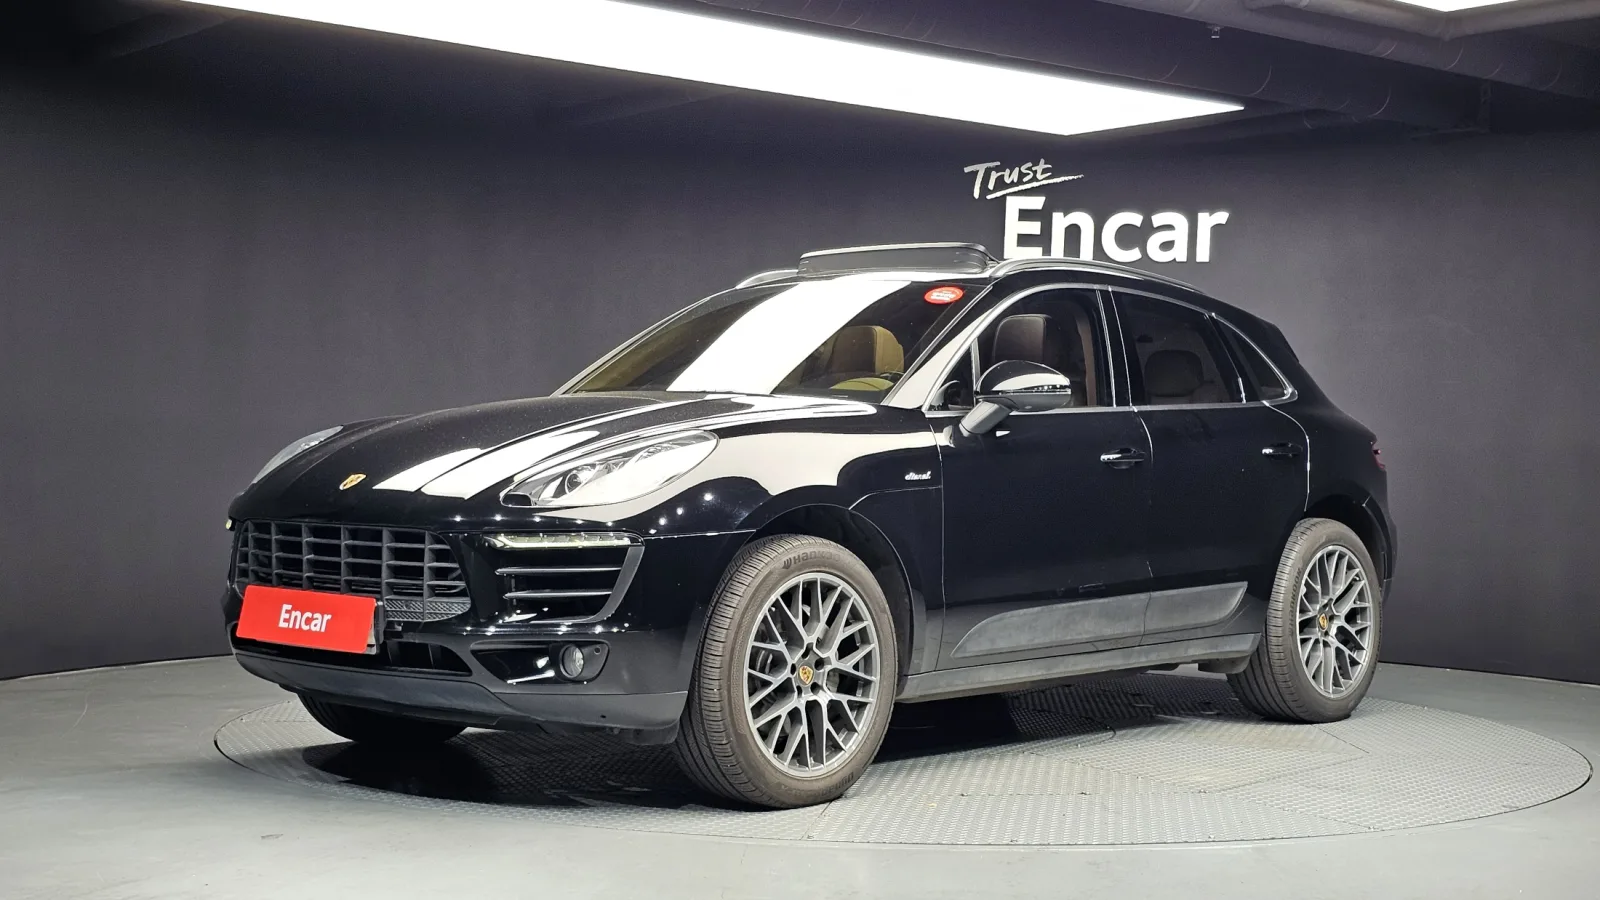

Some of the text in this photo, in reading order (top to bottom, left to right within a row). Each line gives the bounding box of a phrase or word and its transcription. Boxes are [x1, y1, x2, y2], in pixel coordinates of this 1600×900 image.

[964, 158, 1052, 199] Trust
[1003, 196, 1230, 262] Encar
[278, 603, 332, 632] Encar
